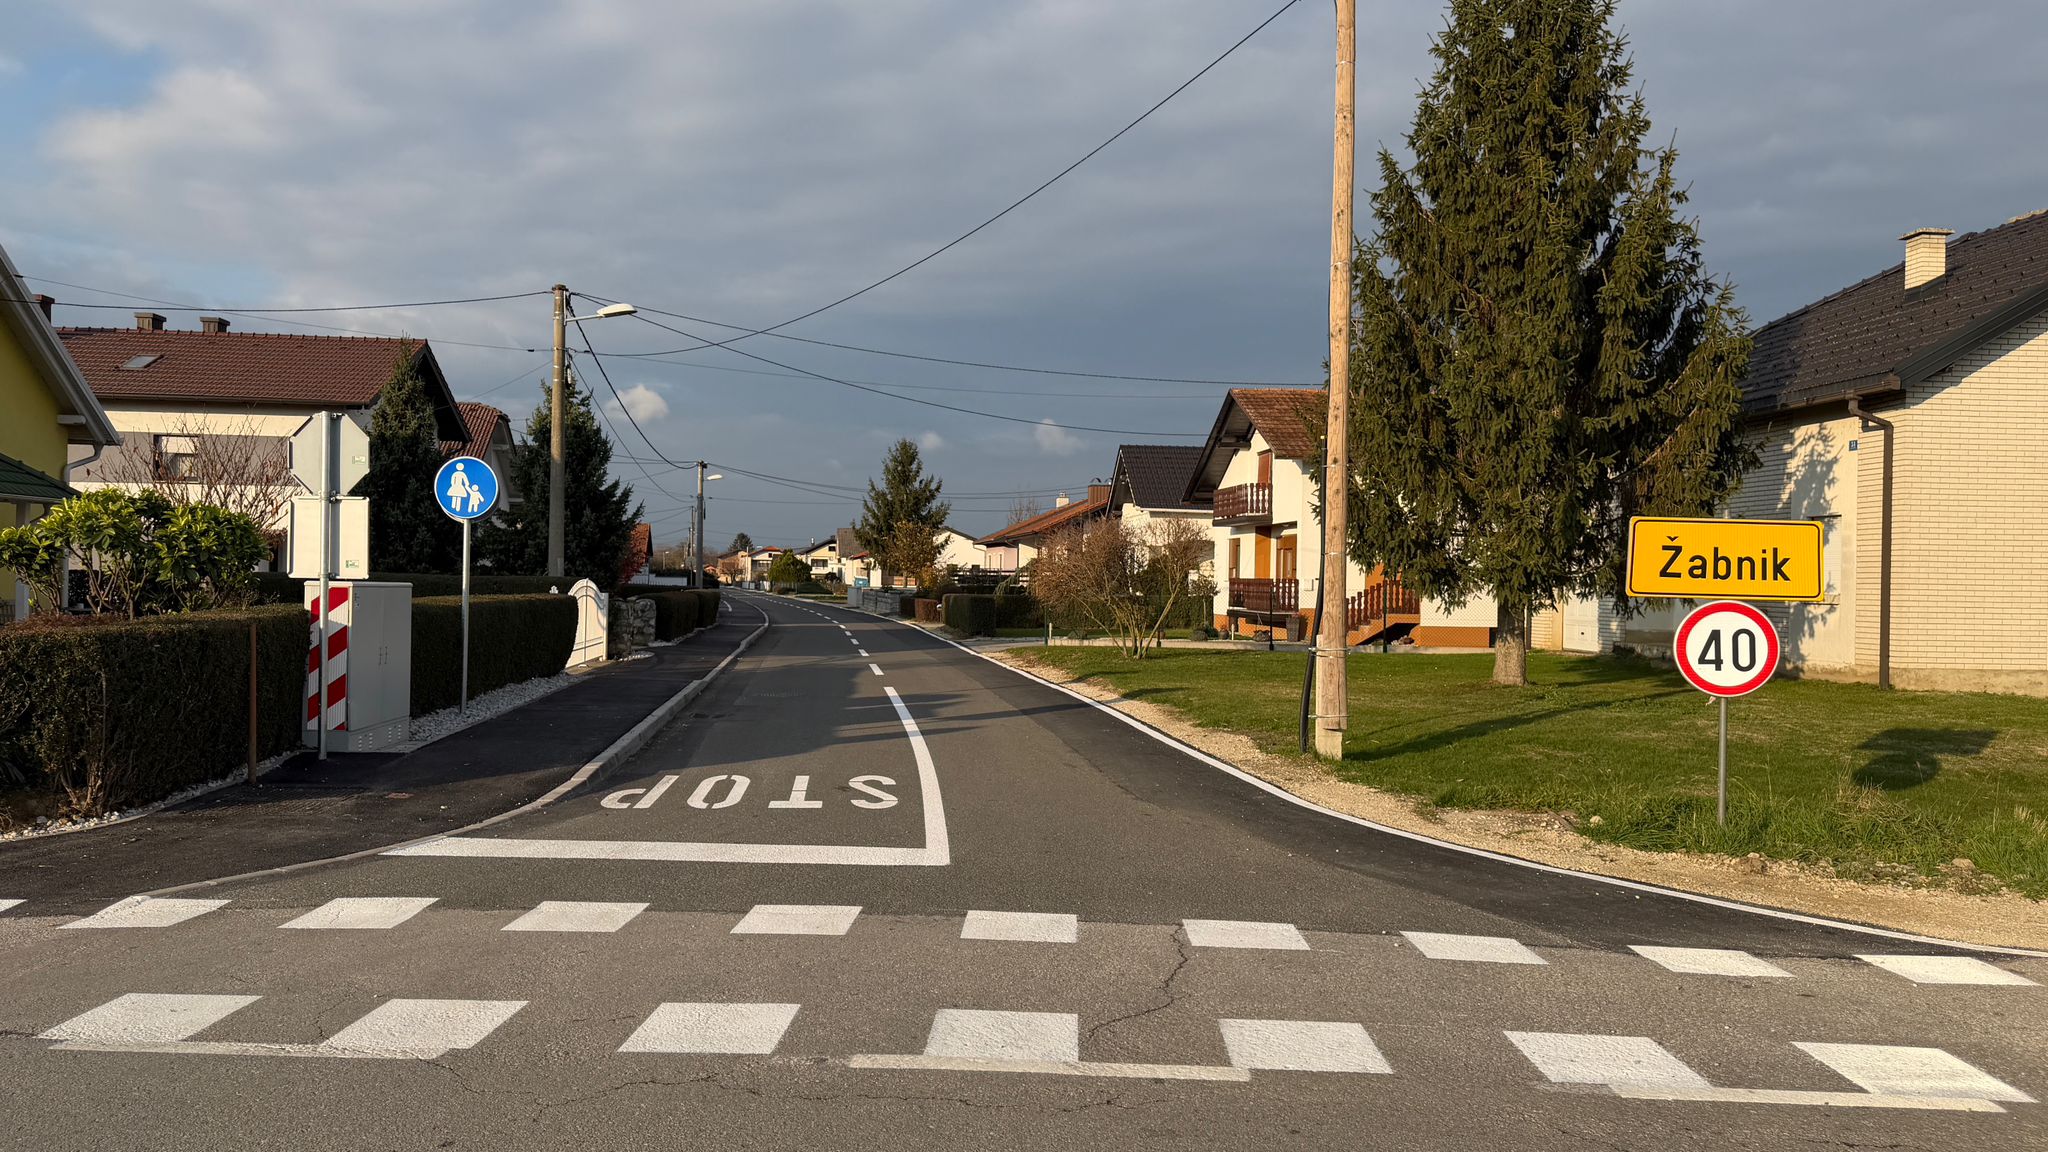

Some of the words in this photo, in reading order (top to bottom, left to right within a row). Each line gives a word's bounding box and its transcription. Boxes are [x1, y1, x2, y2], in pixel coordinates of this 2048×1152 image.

[1659, 535, 1791, 581] Žabnik
[1698, 628, 1756, 672] 40
[600, 774, 899, 809] STOP
